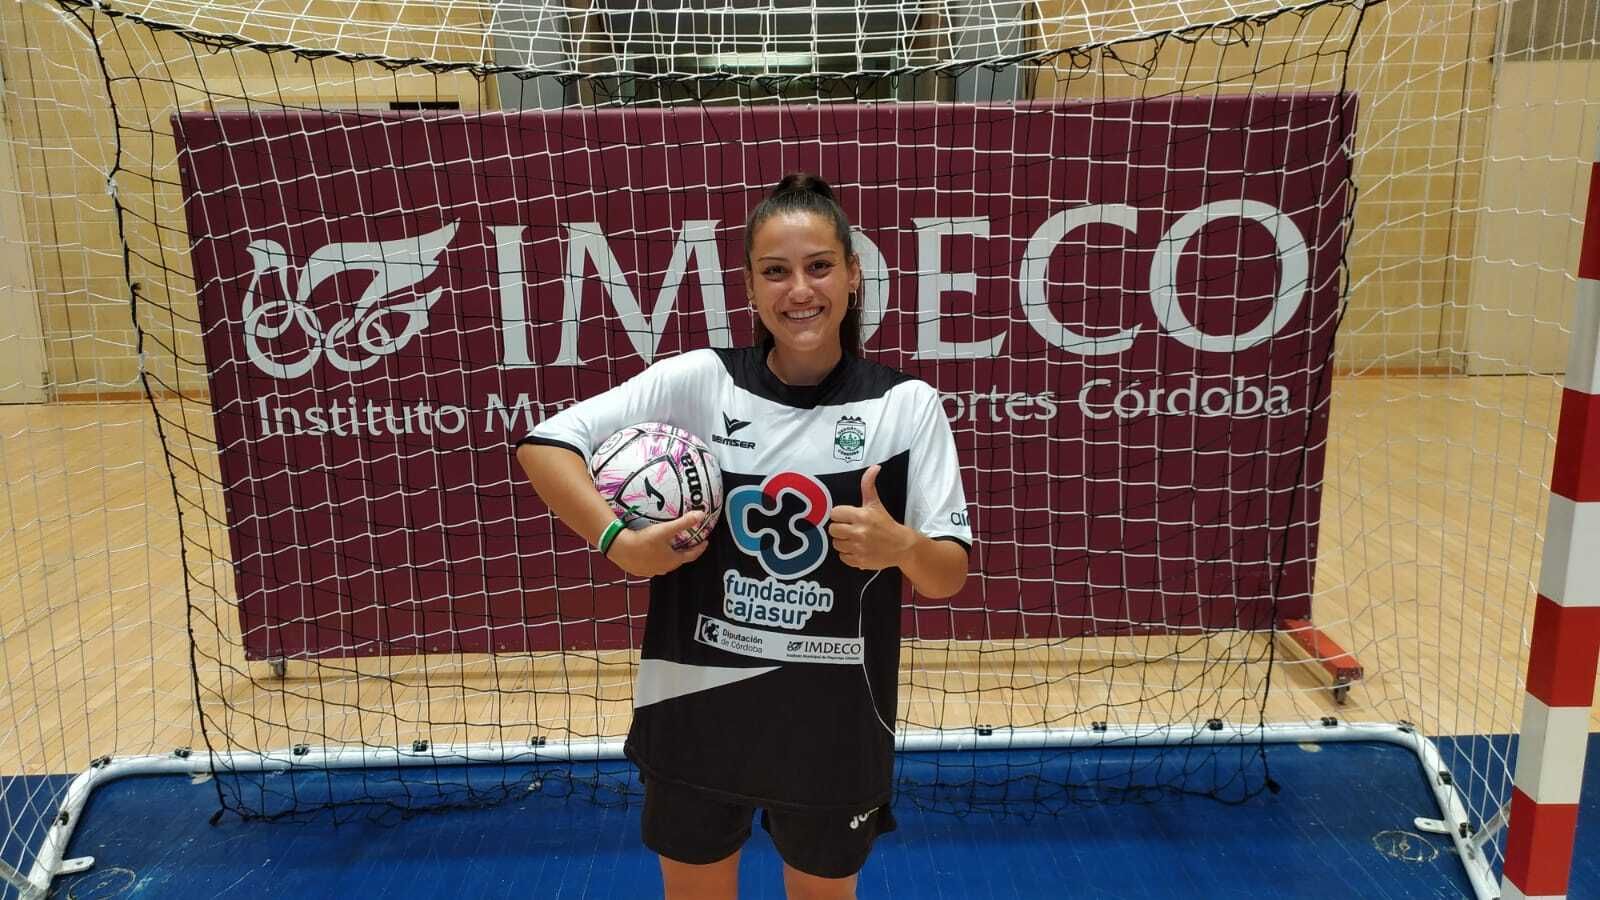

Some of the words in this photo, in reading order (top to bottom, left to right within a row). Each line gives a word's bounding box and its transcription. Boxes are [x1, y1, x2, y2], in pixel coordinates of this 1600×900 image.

[486, 199, 1310, 371] IMECO
[256, 394, 466, 437] Instituto
[938, 384, 1058, 423] ortes
[1079, 376, 1290, 421] Córdoba
[726, 574, 831, 608] fundación
[725, 597, 808, 626] cajasur
[722, 628, 763, 645] Diputación
[804, 641, 861, 655] IMDECO
